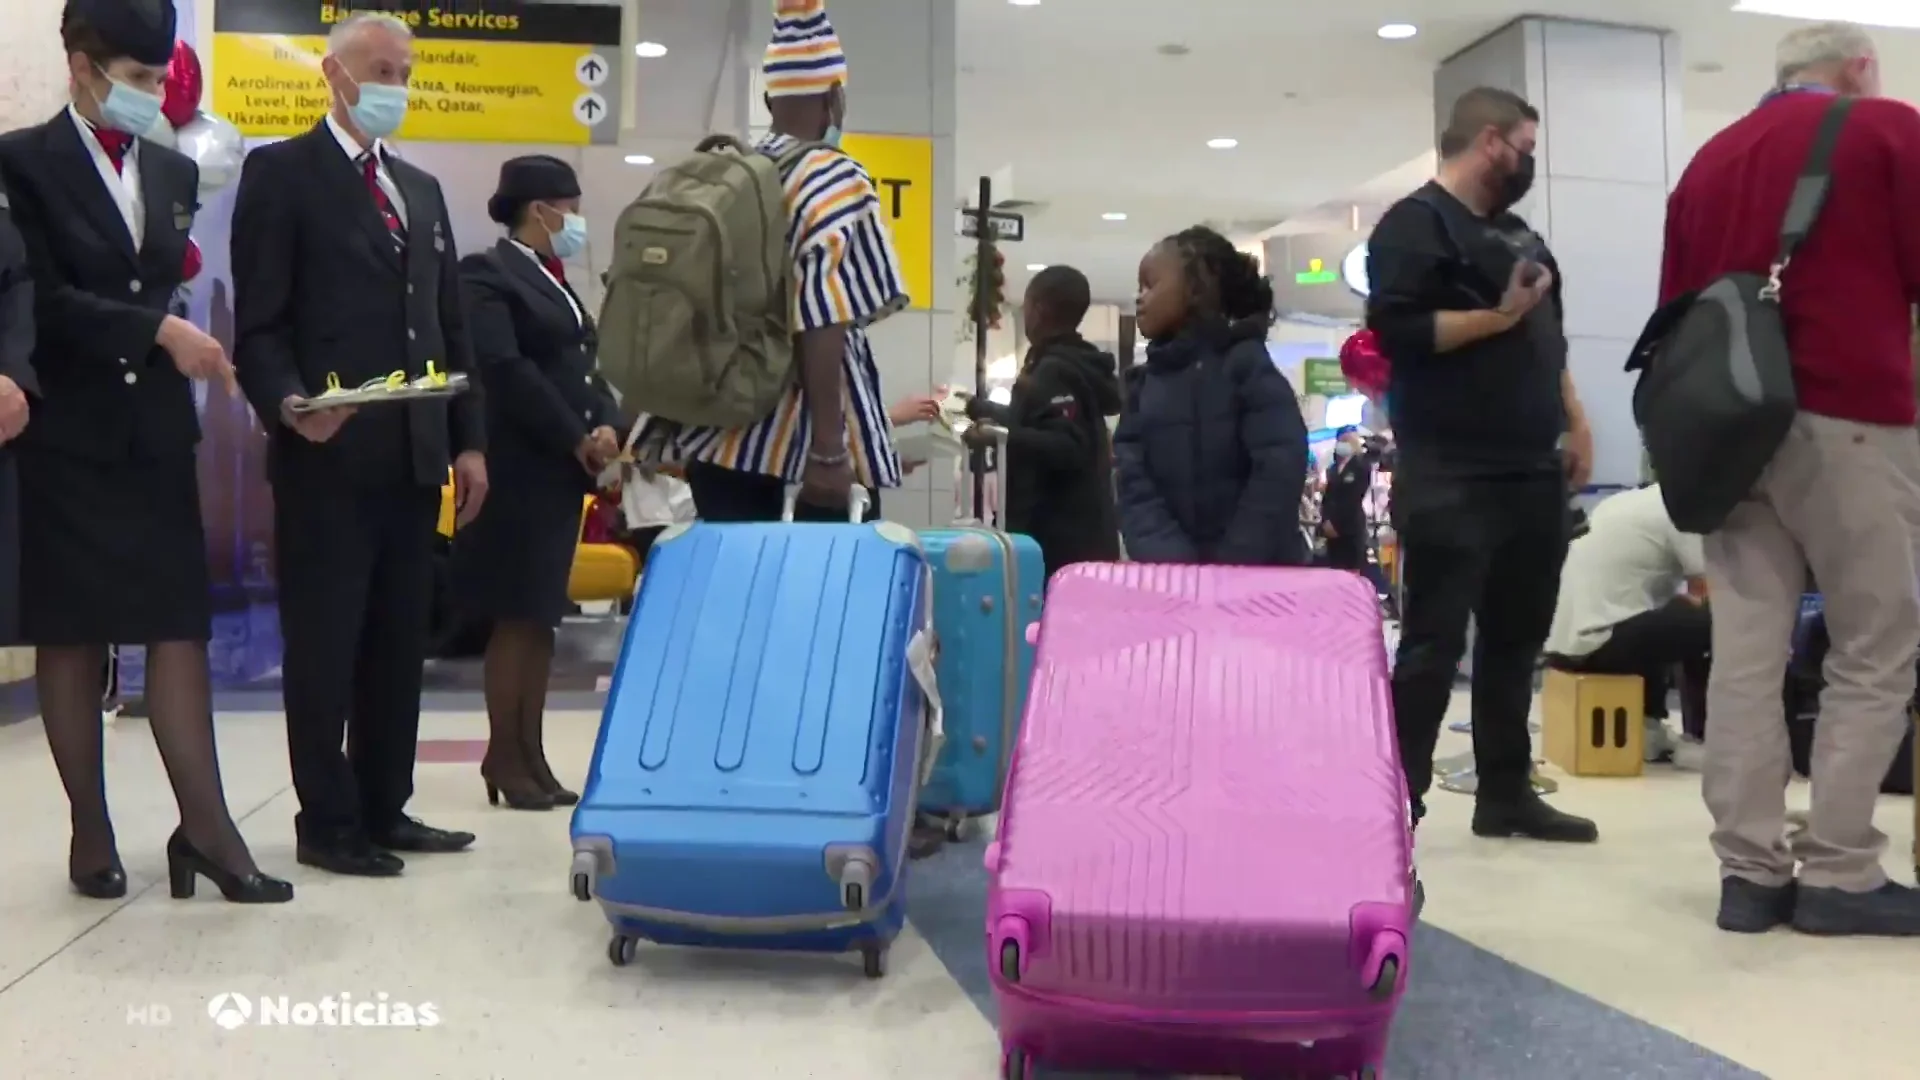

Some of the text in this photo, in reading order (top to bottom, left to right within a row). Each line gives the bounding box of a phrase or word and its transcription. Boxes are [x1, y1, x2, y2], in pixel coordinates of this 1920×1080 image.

[427, 7, 519, 30] Services
[227, 76, 311, 91] Aerolineas
[454, 81, 543, 98] Norwegian,
[245, 95, 289, 109] Level,
[436, 98, 485, 114] Qatar,
[227, 111, 290, 126] Ukraine
